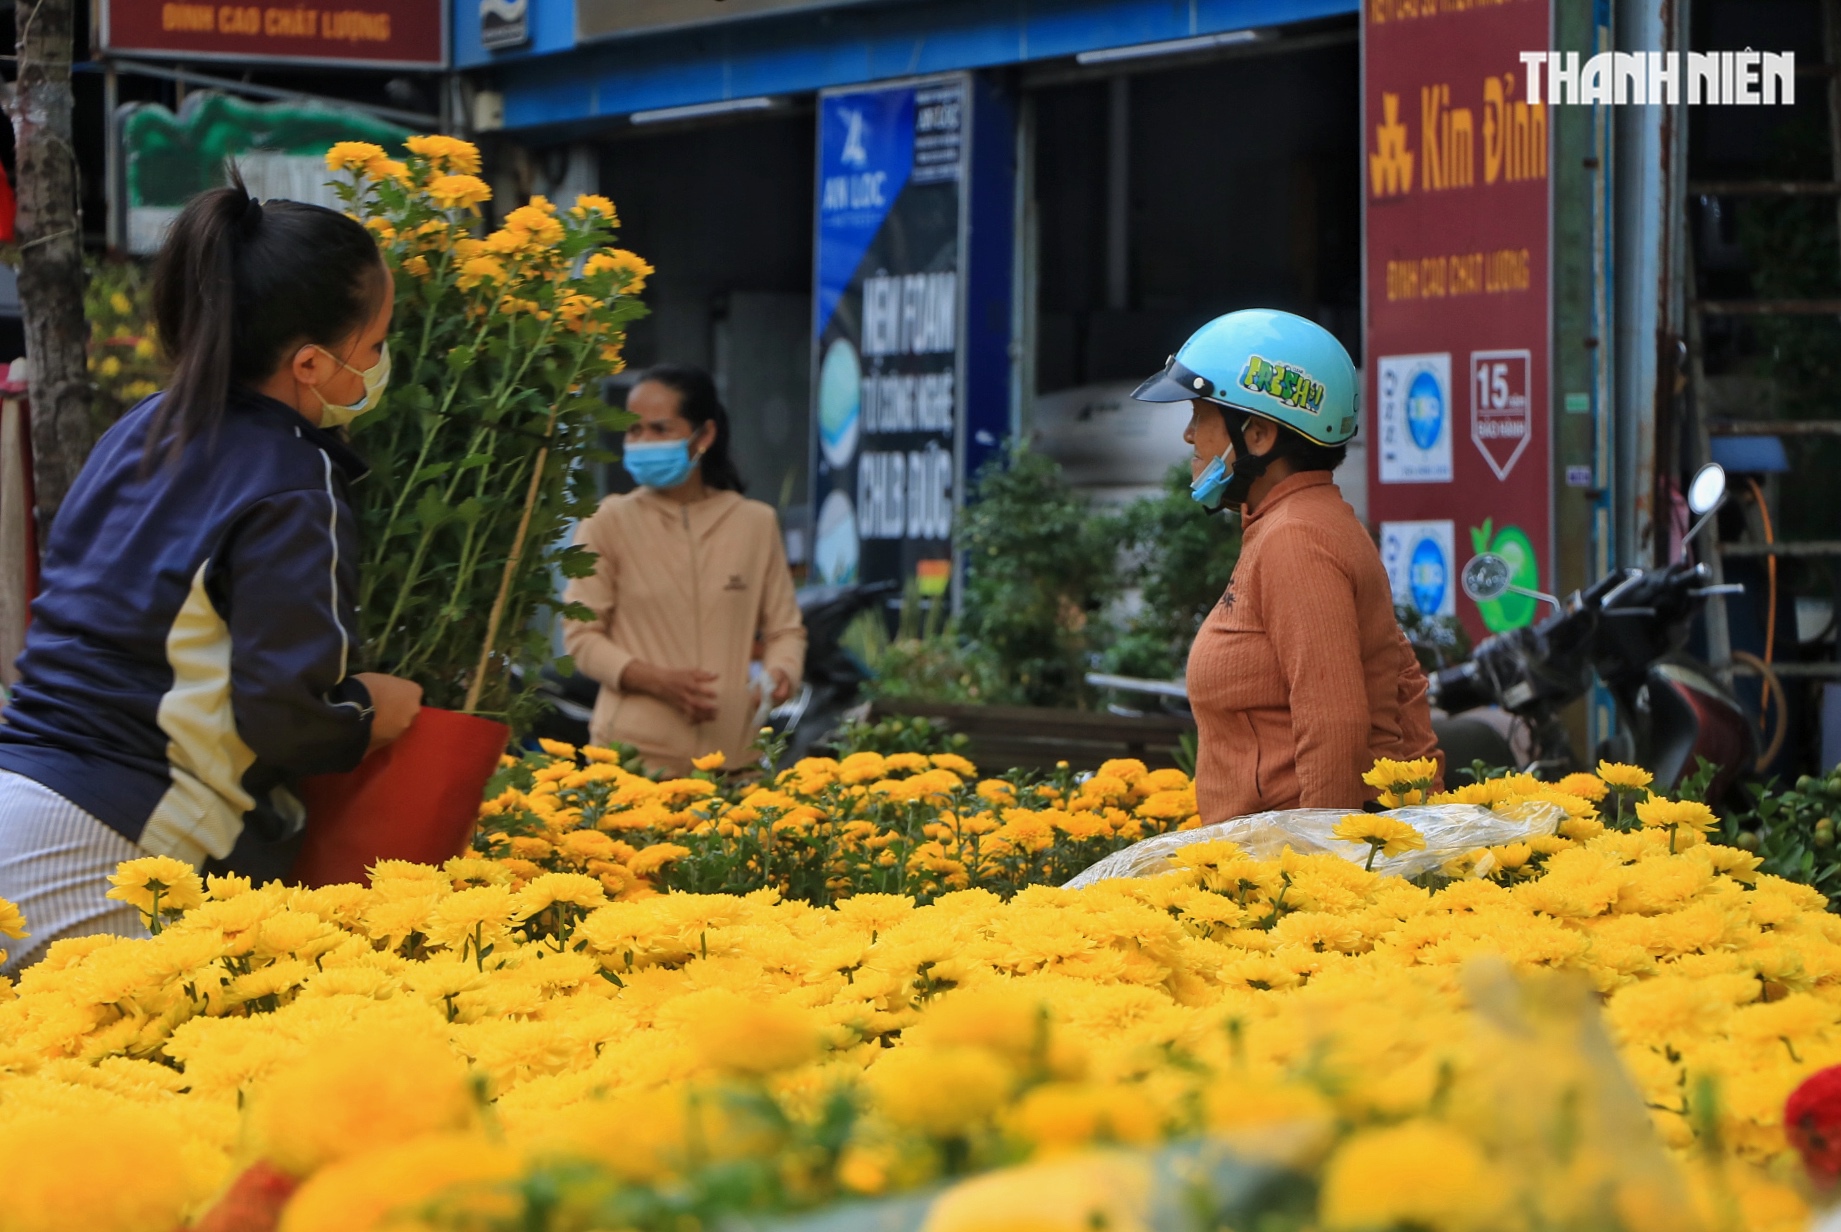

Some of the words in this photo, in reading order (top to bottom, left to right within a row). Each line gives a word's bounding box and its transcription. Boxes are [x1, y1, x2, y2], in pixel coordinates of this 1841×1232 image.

[218, 6, 260, 34] CAO
[1421, 83, 1474, 191] Kim
[823, 175, 849, 210] AN
[1476, 362, 1509, 409] 15
